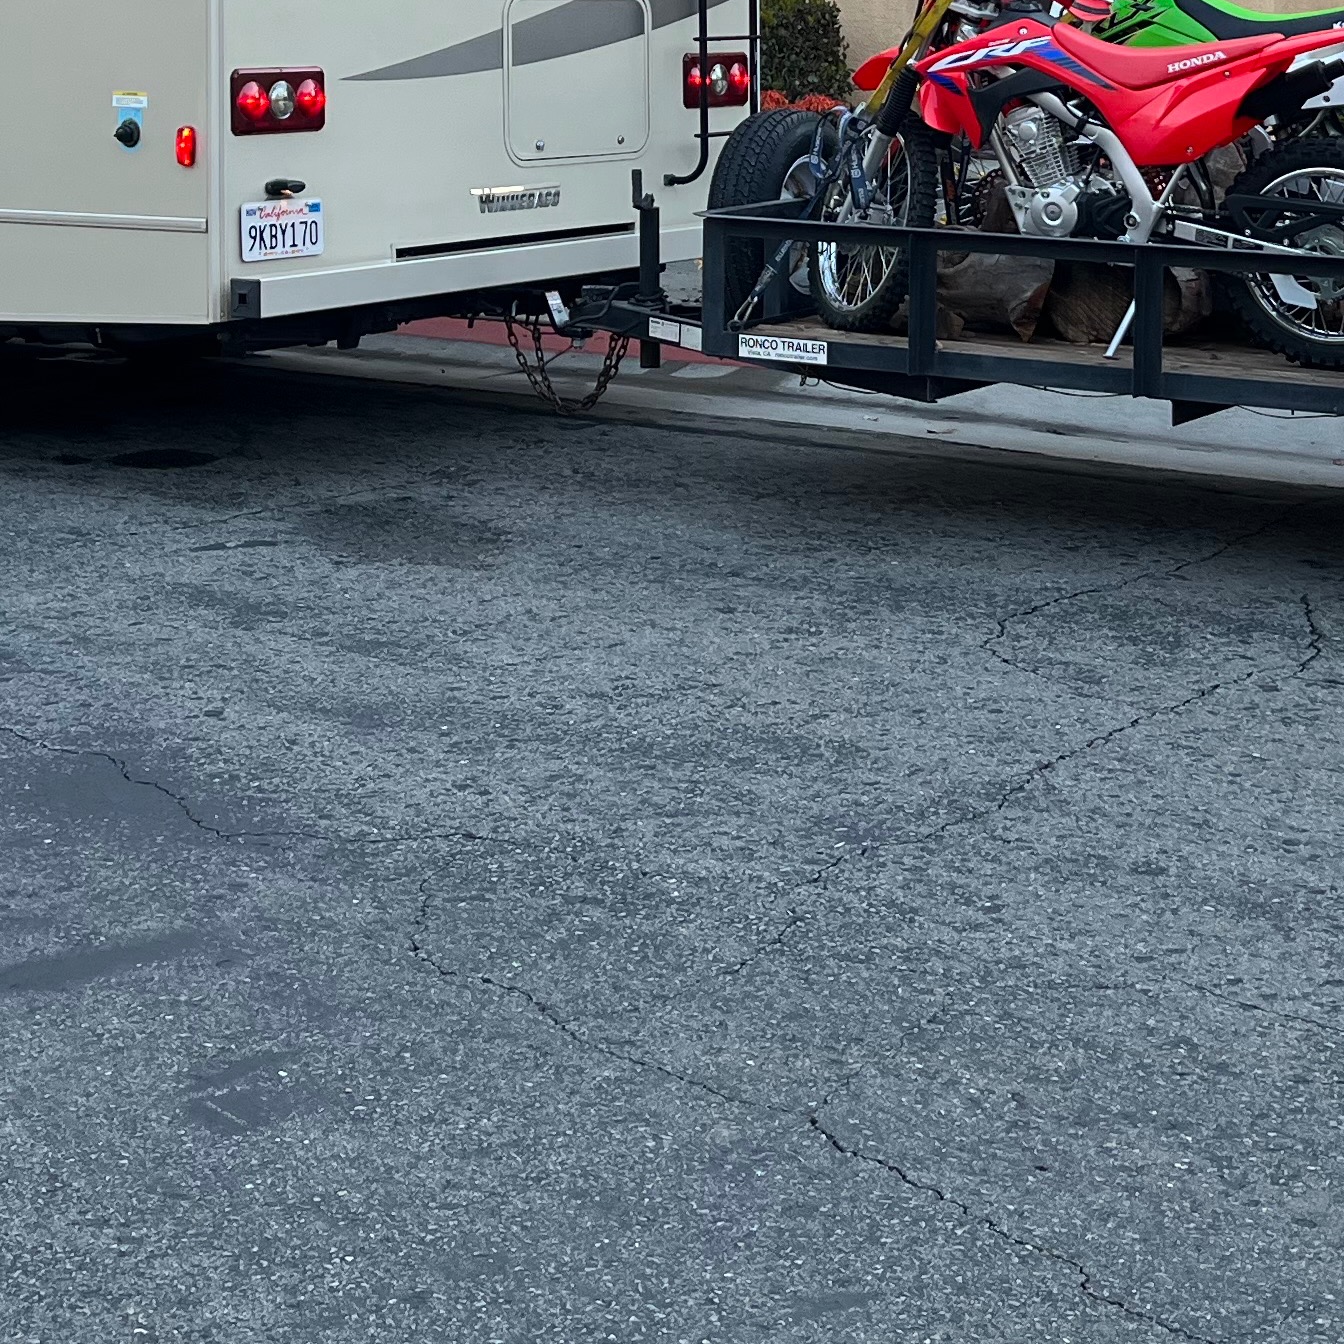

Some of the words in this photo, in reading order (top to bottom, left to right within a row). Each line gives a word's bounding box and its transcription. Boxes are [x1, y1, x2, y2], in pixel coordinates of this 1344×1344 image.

[926, 36, 1053, 73] CRF
[1167, 50, 1227, 74] HONDA
[258, 205, 308, 222] California
[478, 189, 561, 214] WINNEBAGO
[248, 220, 318, 252] 9KBY170
[740, 336, 778, 351] RONCO
[780, 340, 826, 355] TRAILER
